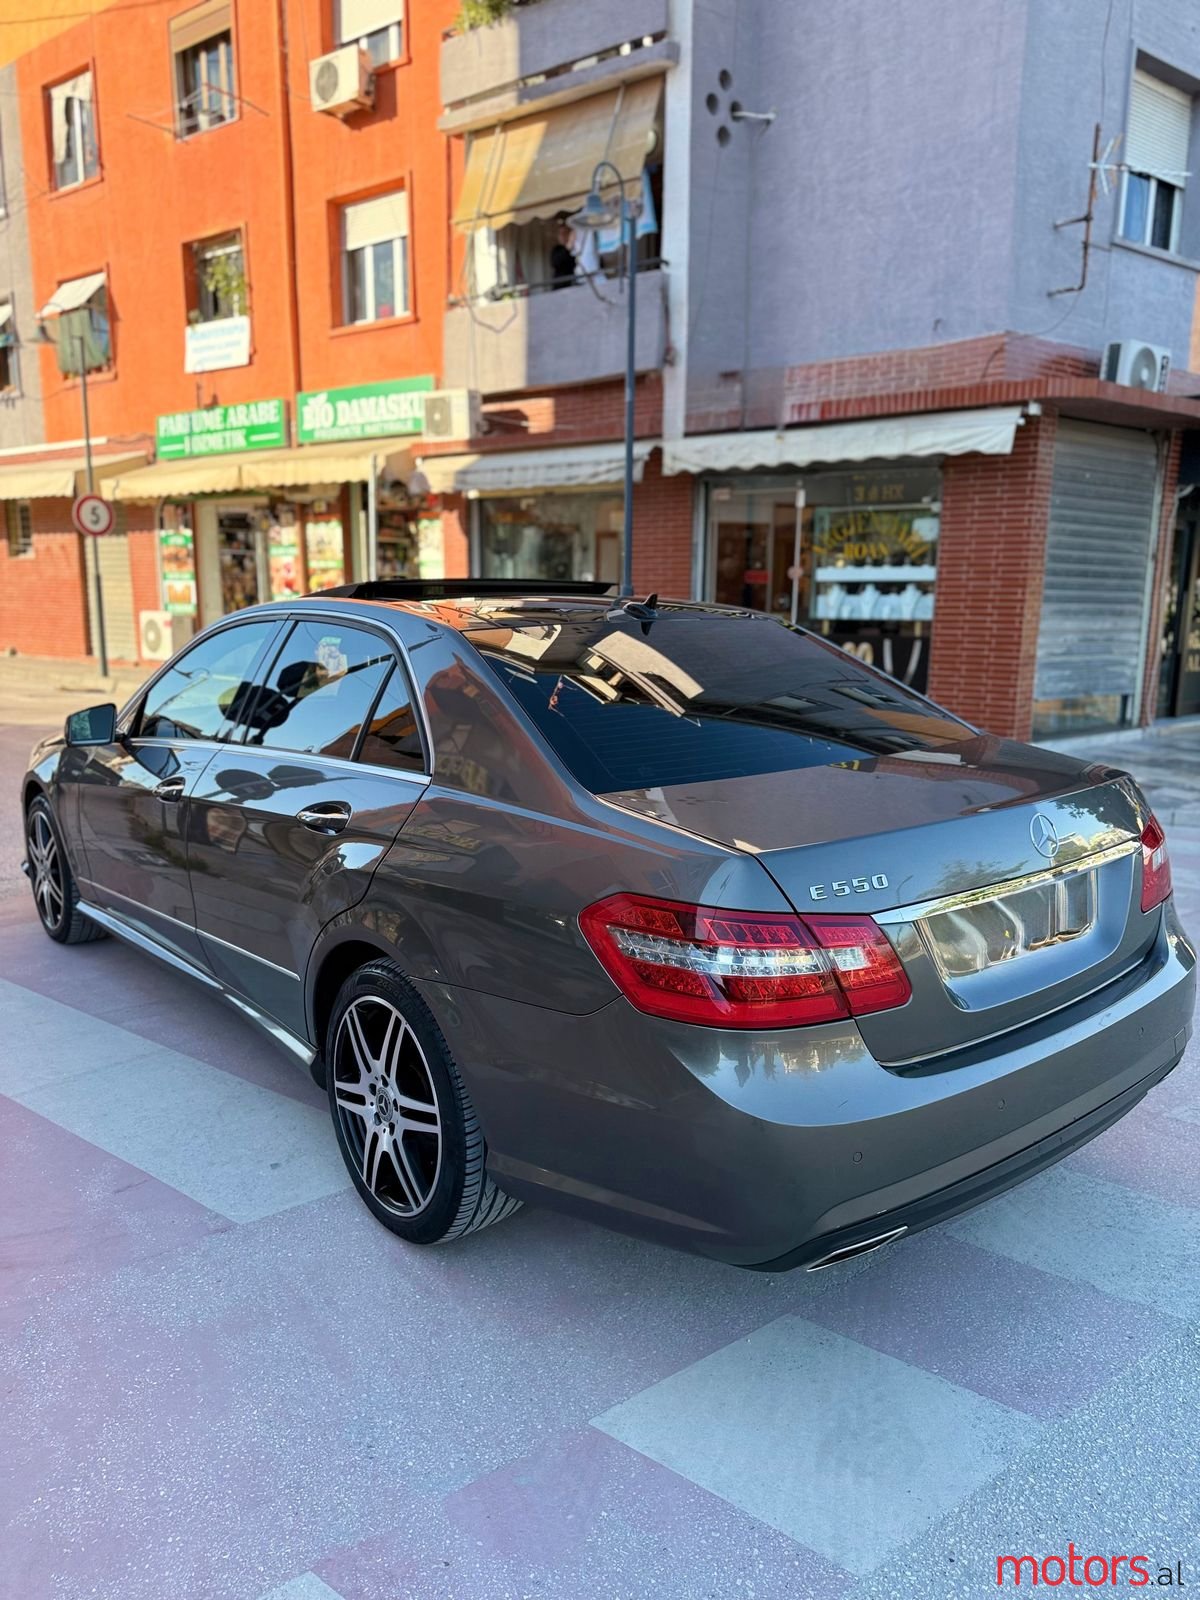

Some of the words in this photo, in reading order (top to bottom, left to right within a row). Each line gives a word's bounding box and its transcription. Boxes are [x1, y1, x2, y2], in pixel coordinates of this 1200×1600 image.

[227, 400, 280, 428] ARABE
[302, 401, 334, 430] BIO
[90, 504, 101, 526] 5
[809, 884, 828, 901] E
[831, 873, 889, 896] 550
